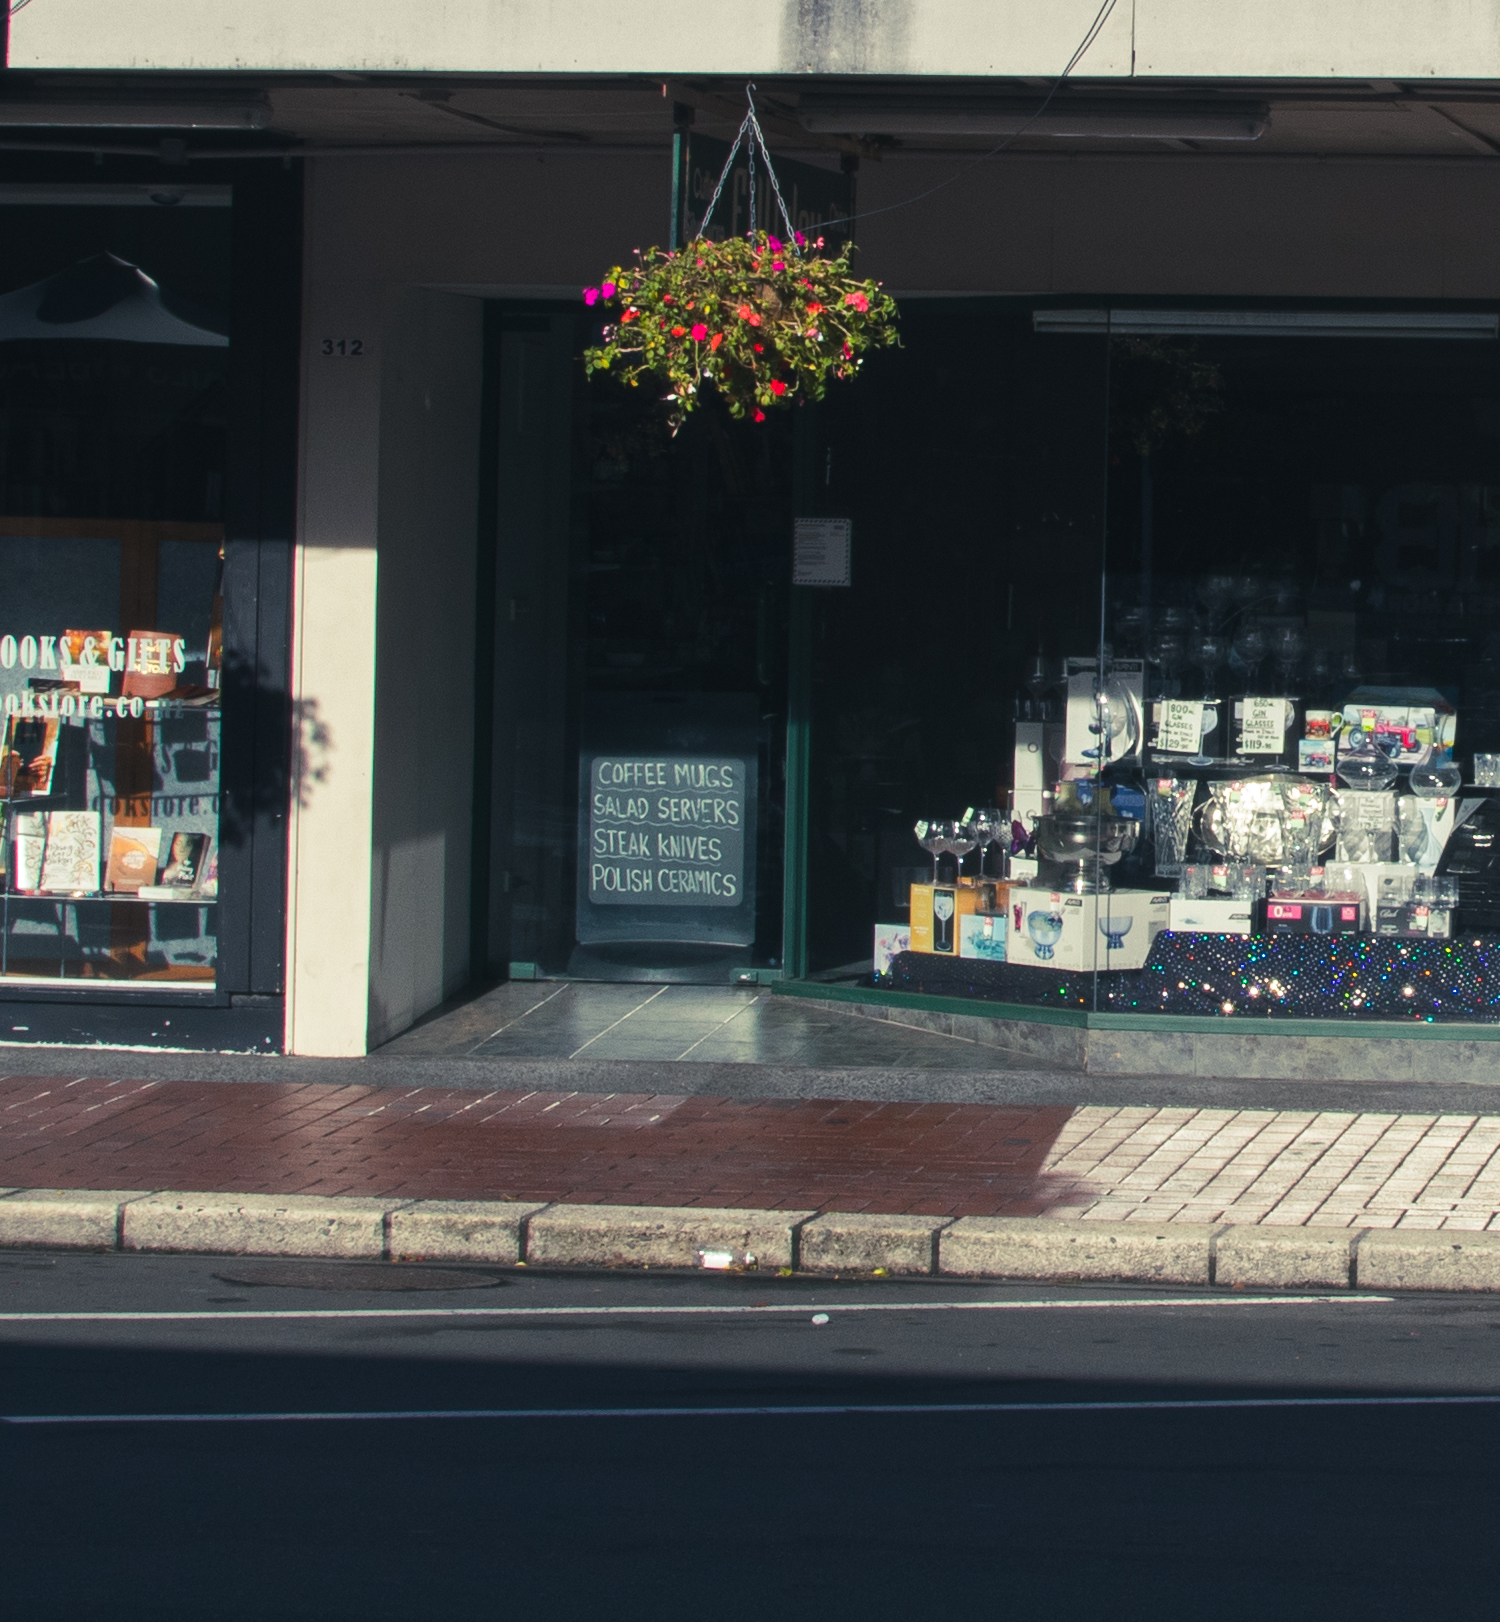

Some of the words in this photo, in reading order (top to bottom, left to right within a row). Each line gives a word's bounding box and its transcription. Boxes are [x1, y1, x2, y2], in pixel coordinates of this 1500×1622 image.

[321, 339, 364, 356] 312
[79, 637, 101, 669] &
[106, 636, 186, 673] GIFTS
[599, 761, 667, 785] COFFEE
[673, 764, 734, 788] MUGS
[593, 794, 649, 819] SALAD
[658, 796, 740, 825] SERVERS
[593, 828, 651, 857] STEAK
[593, 863, 654, 892] POLISH
[657, 868, 737, 897] CERAMICS
